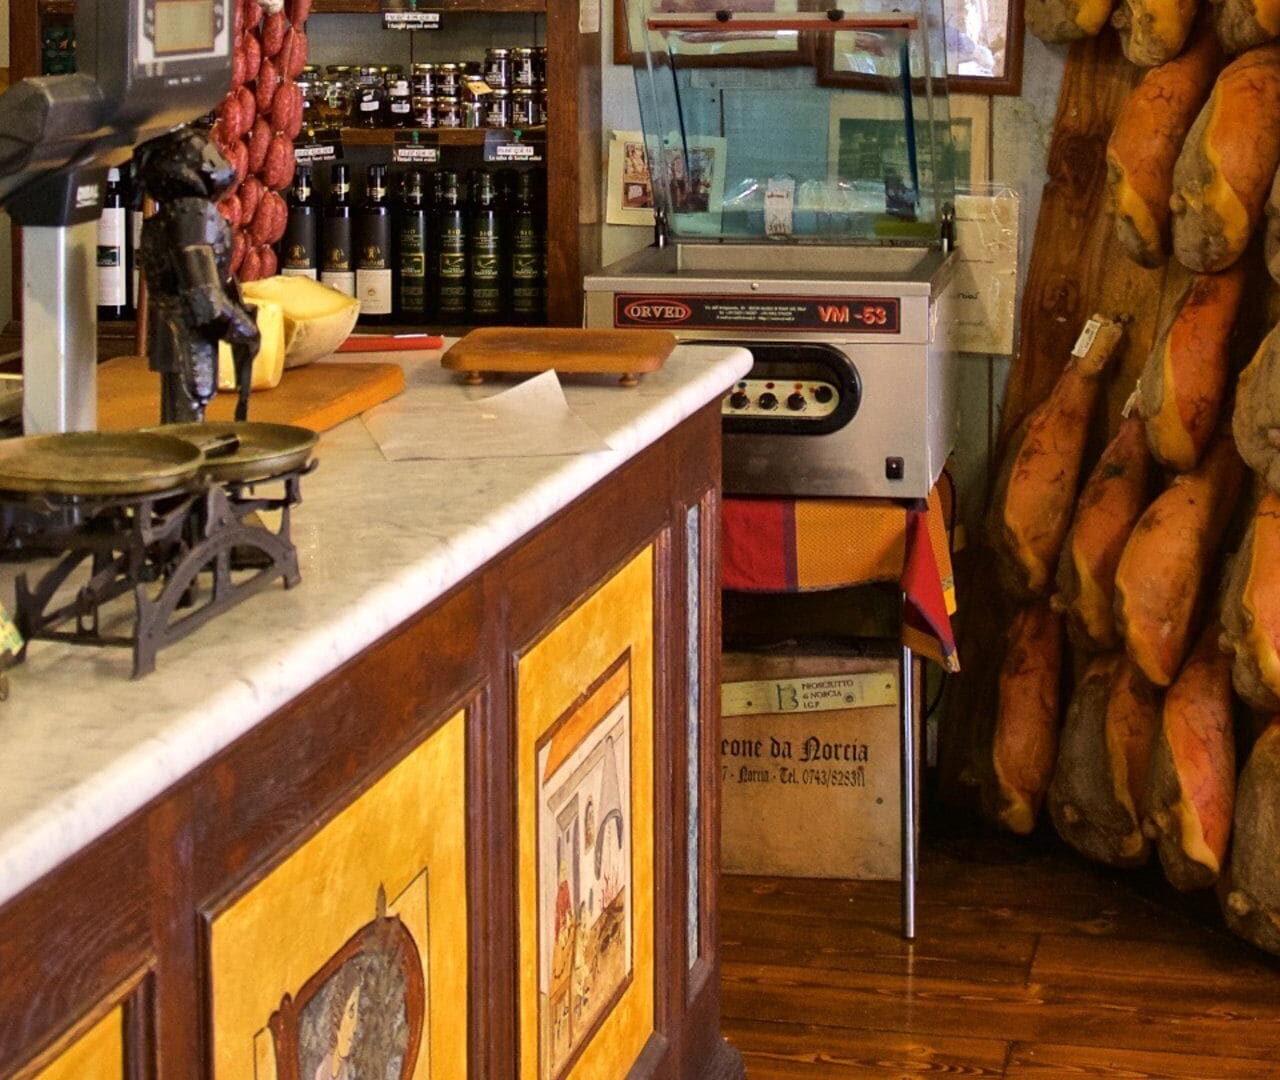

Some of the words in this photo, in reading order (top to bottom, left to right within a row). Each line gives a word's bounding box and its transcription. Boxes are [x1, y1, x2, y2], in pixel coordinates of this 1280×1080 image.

[629, 304, 687, 320] ORVED
[818, 305, 850, 323] VM
[770, 737, 792, 760] da
[799, 736, 870, 763] Norcia
